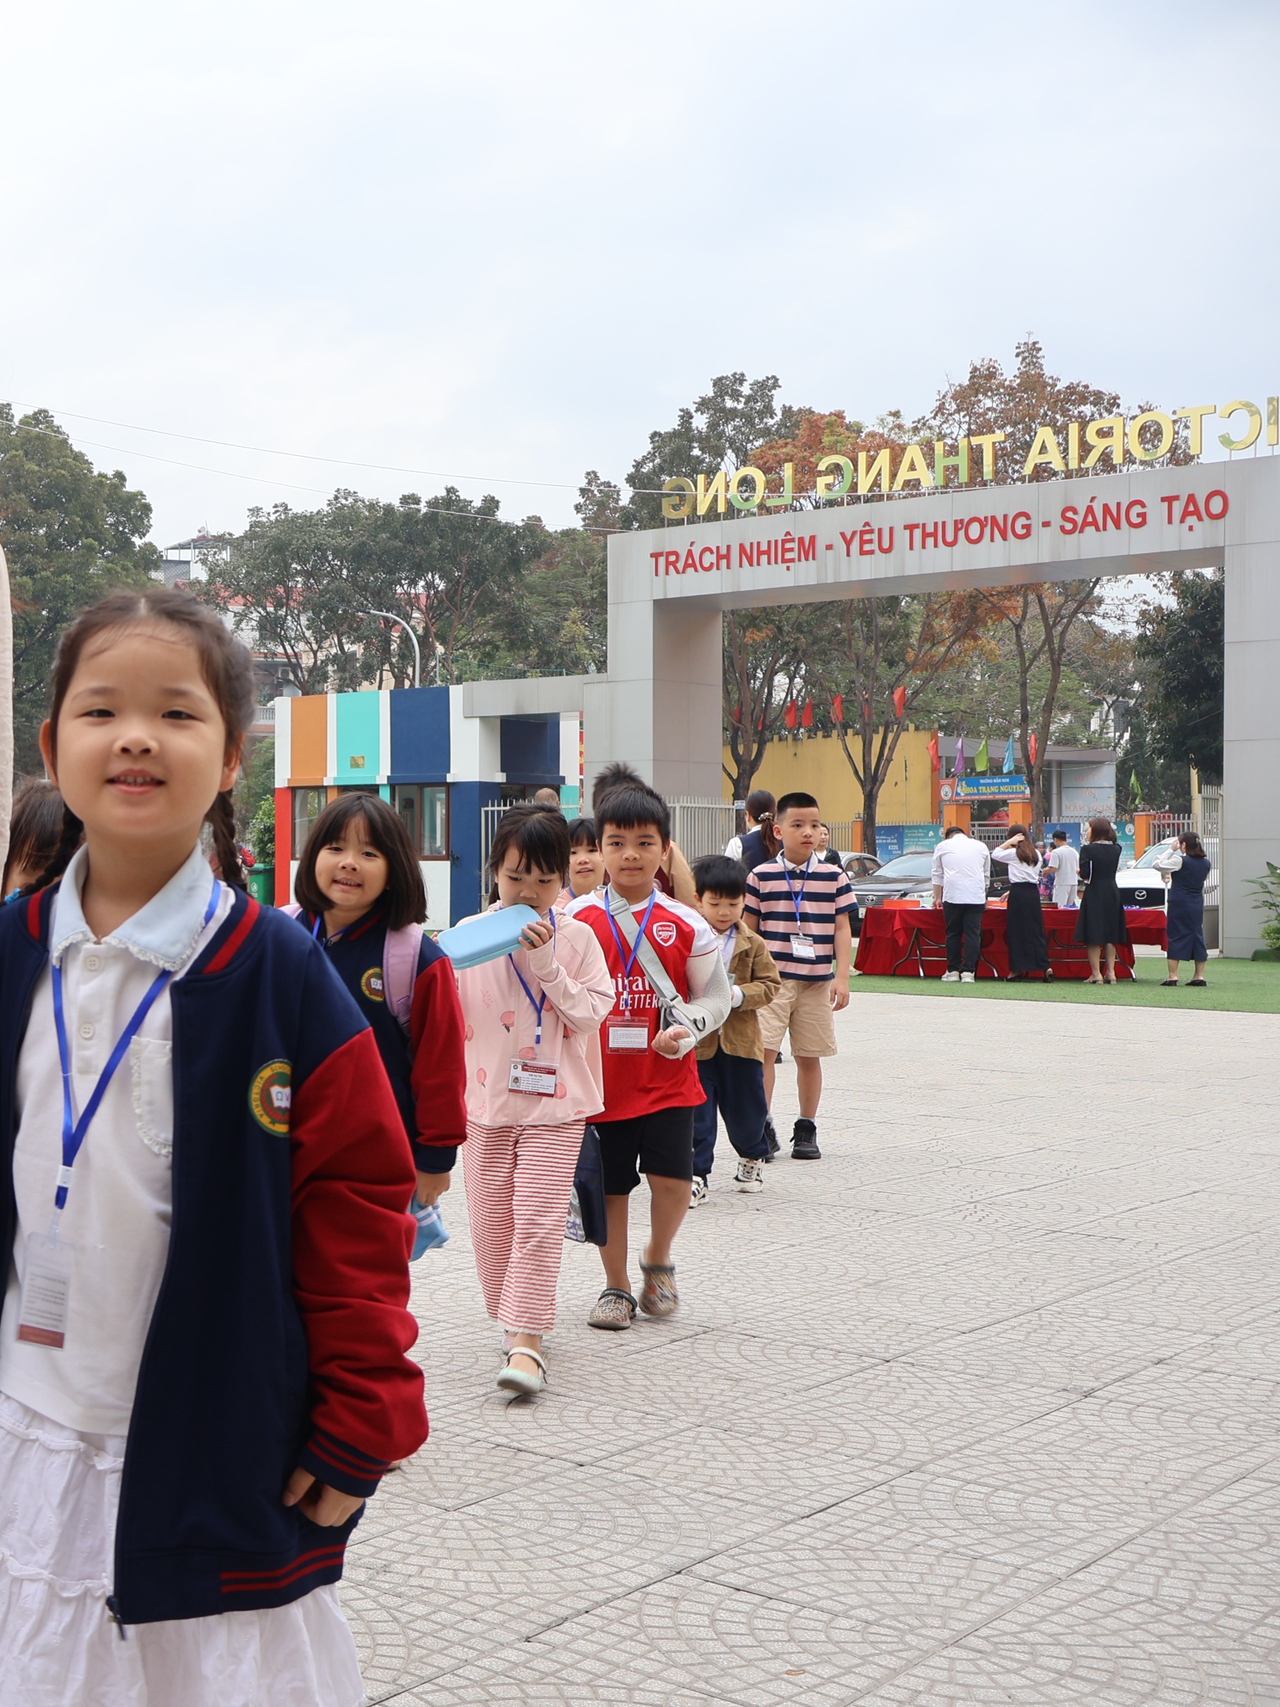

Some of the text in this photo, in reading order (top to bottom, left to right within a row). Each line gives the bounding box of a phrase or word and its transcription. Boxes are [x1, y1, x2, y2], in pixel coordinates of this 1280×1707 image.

[649, 541, 732, 577] TRÁCH
[738, 530, 817, 571] NHIỆM
[839, 521, 895, 557] YÊU
[903, 511, 1032, 551] THƯƠNG
[1059, 496, 1148, 535] SÁNG
[1160, 489, 1230, 532] TẠO
[1000, 783, 1025, 793] NGUYÊN
